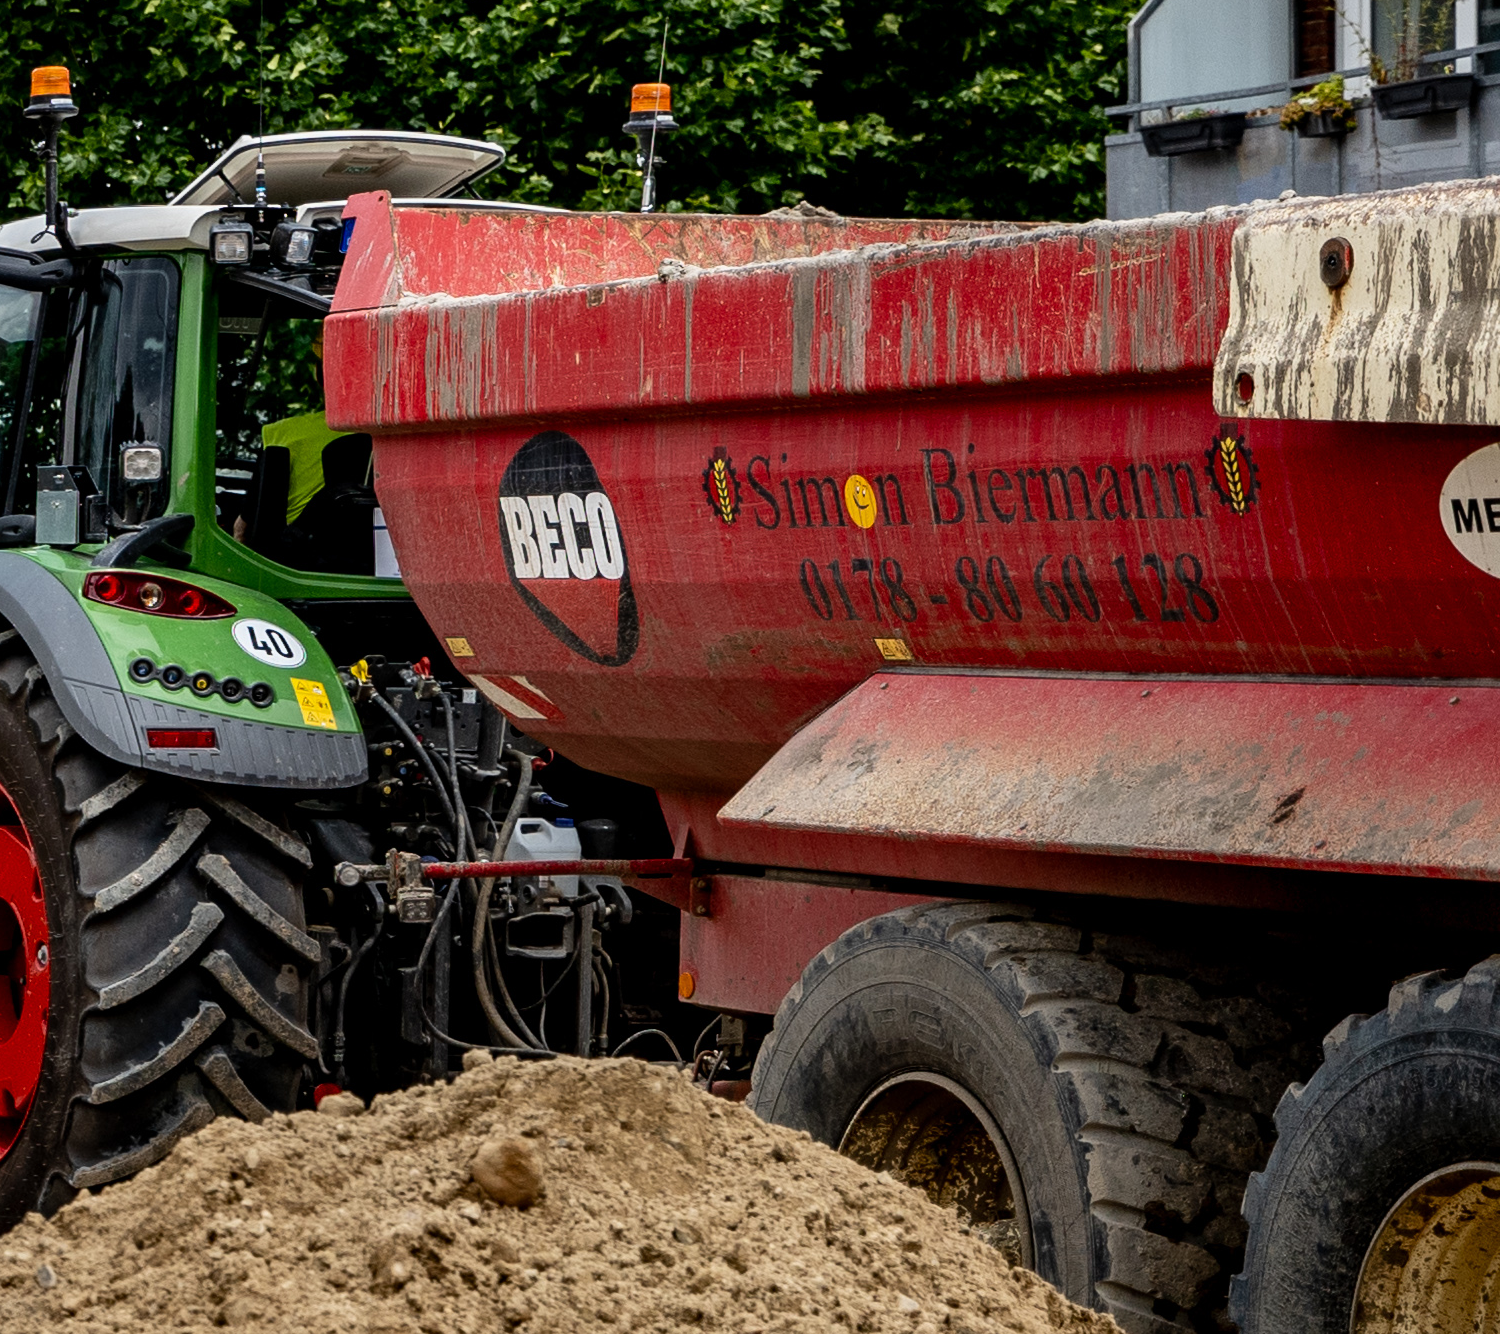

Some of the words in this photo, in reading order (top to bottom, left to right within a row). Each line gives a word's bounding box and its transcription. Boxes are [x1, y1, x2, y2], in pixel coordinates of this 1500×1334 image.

[919, 443, 1209, 525] Biermann
[500, 492, 624, 579] BECO
[801, 556, 917, 623] 0178
[955, 555, 1023, 622] 80
[1033, 554, 1099, 623] 60
[1111, 553, 1220, 623] 128
[246, 626, 293, 658] 40
